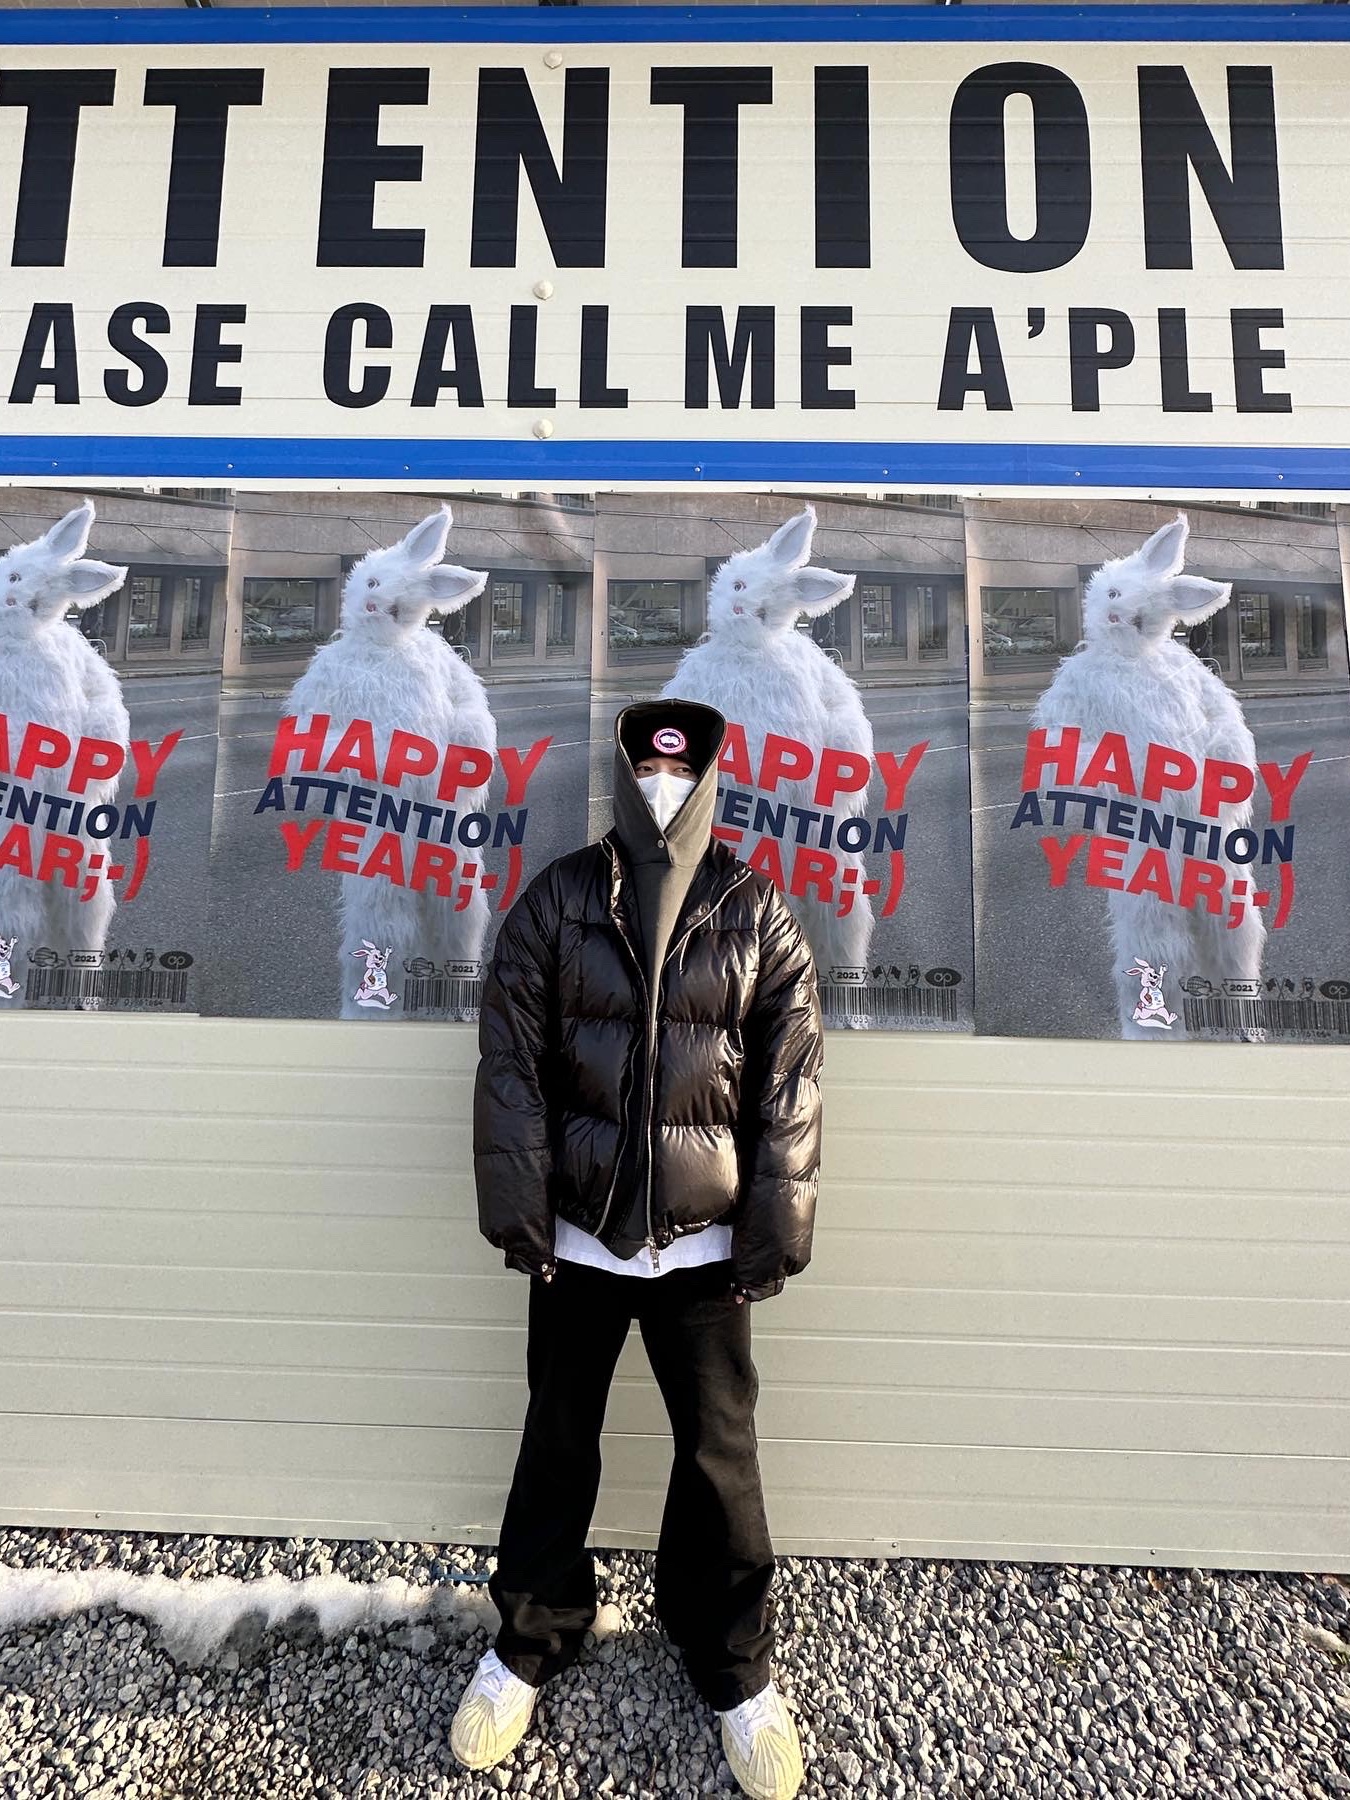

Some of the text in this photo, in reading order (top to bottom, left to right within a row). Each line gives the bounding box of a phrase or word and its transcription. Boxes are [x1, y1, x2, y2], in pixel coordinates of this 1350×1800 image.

[0, 61, 1284, 273] TTENTION
[9, 302, 1292, 412] ASE CALL ME A'PLE
[0, 713, 186, 799] PPY
[267, 712, 554, 807] HAPPY
[1020, 726, 1315, 823] HAPPY
[253, 776, 529, 849] ATTENTION
[716, 786, 908, 854] ENTION
[1010, 790, 1295, 866] ATTENTION
[1038, 833, 1295, 930] YEAR;-)
[74, 955, 97, 963] 2021
[452, 965, 474, 973] 2021
